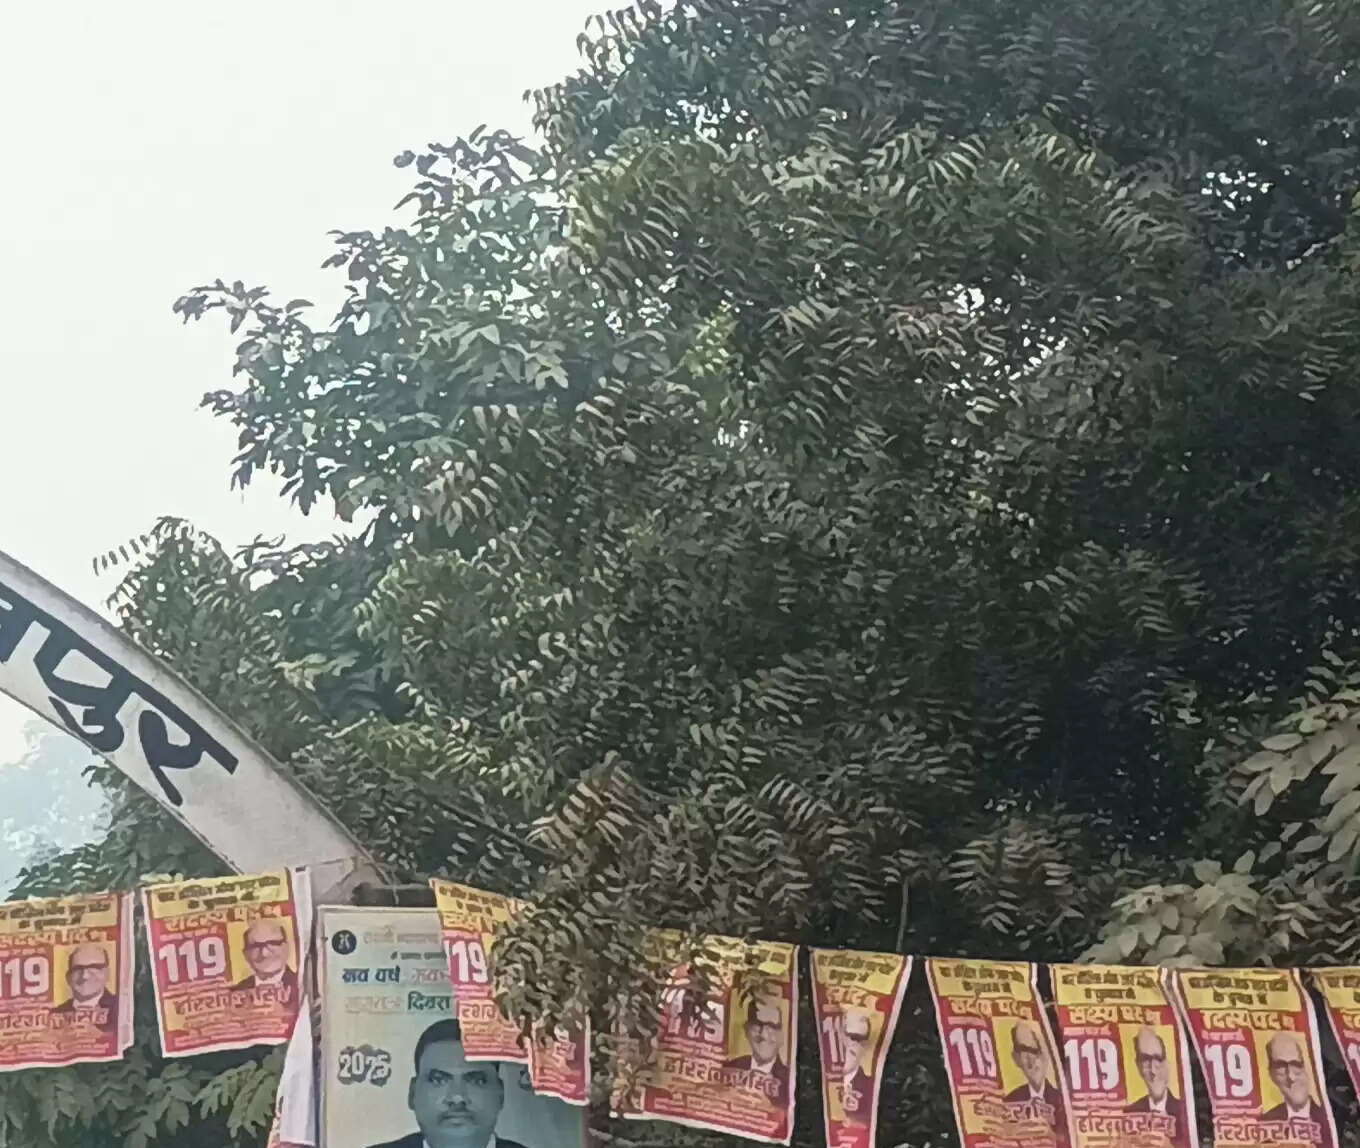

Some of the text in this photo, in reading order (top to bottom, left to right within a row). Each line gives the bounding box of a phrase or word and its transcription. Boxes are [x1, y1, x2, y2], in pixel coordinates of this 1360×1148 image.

[158, 936, 227, 984] 119
[342, 967, 370, 983] नव
[949, 1027, 997, 1078] 119
[1063, 1038, 1120, 1091] 119
